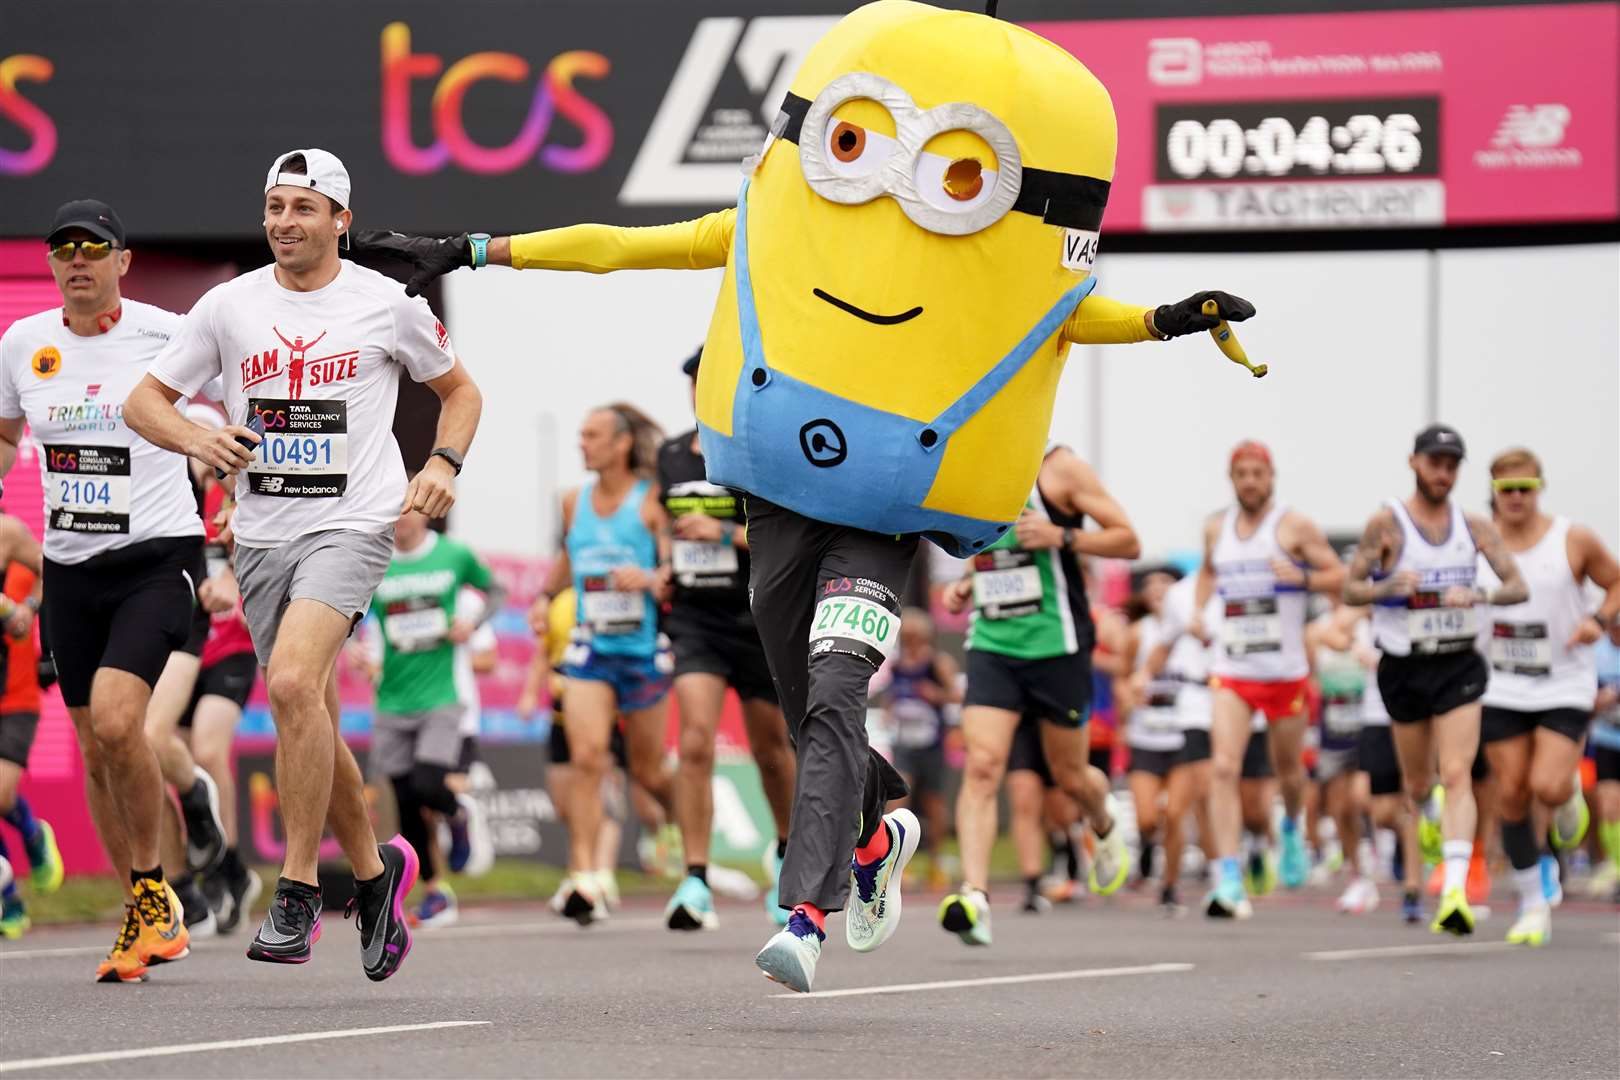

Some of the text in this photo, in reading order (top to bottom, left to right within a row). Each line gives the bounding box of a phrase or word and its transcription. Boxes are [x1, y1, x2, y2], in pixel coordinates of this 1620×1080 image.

[380, 21, 615, 176] tcs
[1167, 113, 1422, 178] 00:04:26
[241, 349, 359, 387] TEAM SUZE
[48, 403, 124, 421] TRIATHLO
[289, 405, 311, 413] TATA
[289, 413, 341, 421] CONSULTANCY
[65, 421, 117, 432] WORLD
[289, 421, 322, 429] SERVICES
[50, 447, 78, 470] tcs
[259, 437, 332, 465] 10491
[79, 456, 125, 466] CONSULTAY
[79, 464, 108, 472] SERVICES
[61, 480, 111, 504] 2104
[284, 485, 338, 495] new balance
[73, 520, 121, 531] new balance
[854, 585, 887, 602] SERVICES
[856, 577, 898, 603] CONSULTANCY
[816, 603, 890, 642] 27460
